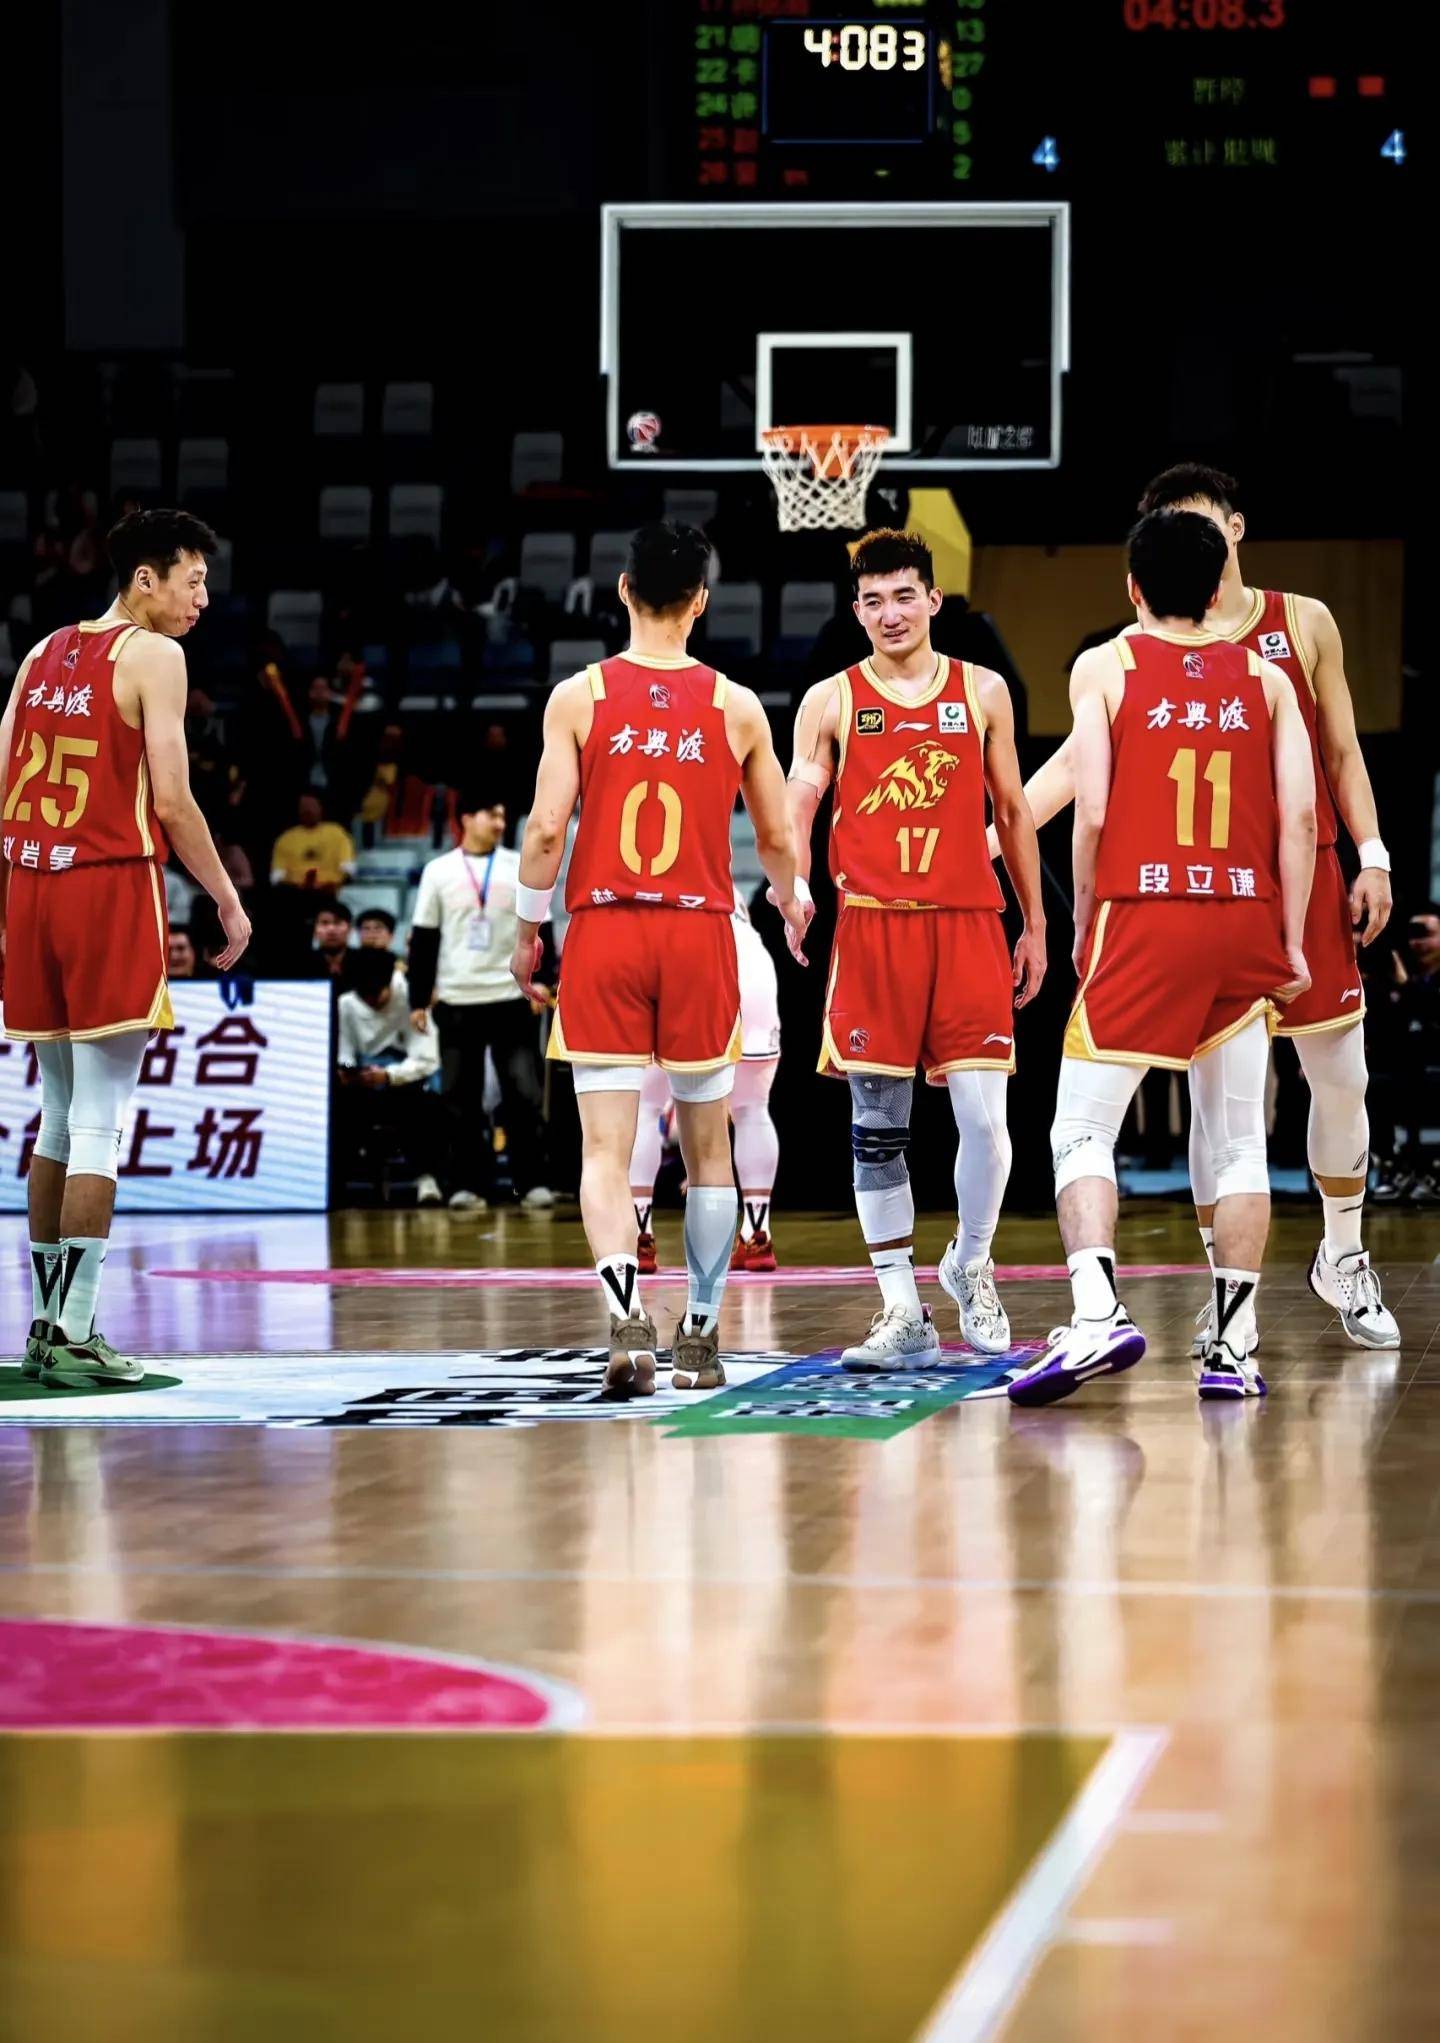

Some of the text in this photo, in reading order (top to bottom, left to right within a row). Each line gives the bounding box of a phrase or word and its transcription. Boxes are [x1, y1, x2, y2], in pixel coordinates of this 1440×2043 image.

[1124, 0, 1285, 31] 04:08.3
[1032, 136, 1060, 172] 4
[1380, 129, 1407, 165] 4
[3, 729, 98, 829] 25
[1167, 748, 1232, 849] 11
[619, 780, 682, 877] 0
[896, 827, 940, 873] 17
[1138, 863, 1257, 897] 段立谦
